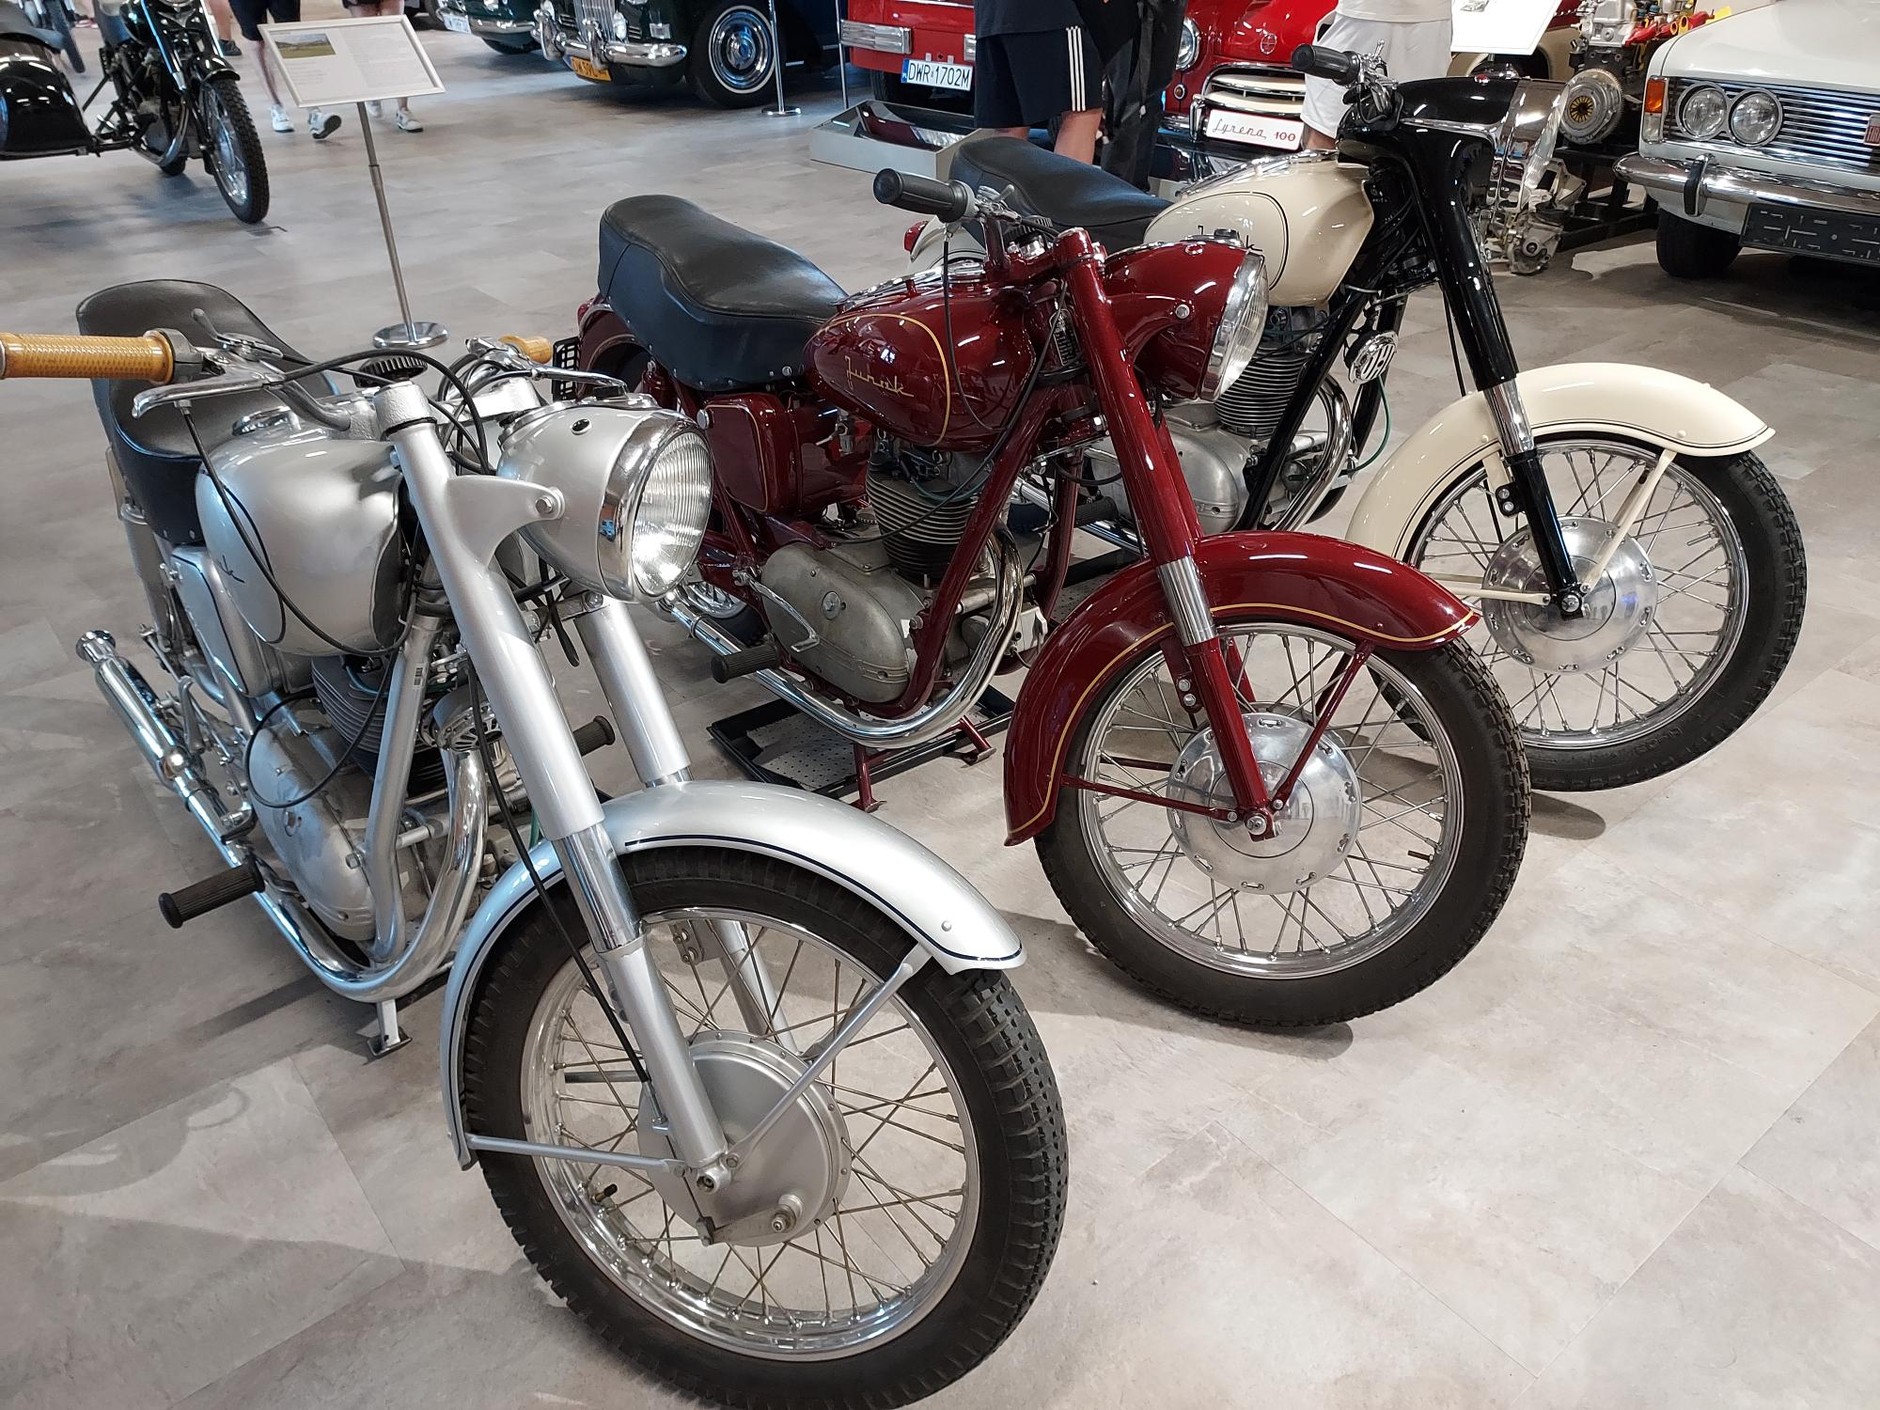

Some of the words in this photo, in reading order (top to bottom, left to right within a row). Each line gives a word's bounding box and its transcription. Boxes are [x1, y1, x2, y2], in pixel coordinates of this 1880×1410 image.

[908, 62, 931, 83] DWR
[935, 65, 971, 88] 1702M
[1274, 130, 1296, 142] 100
